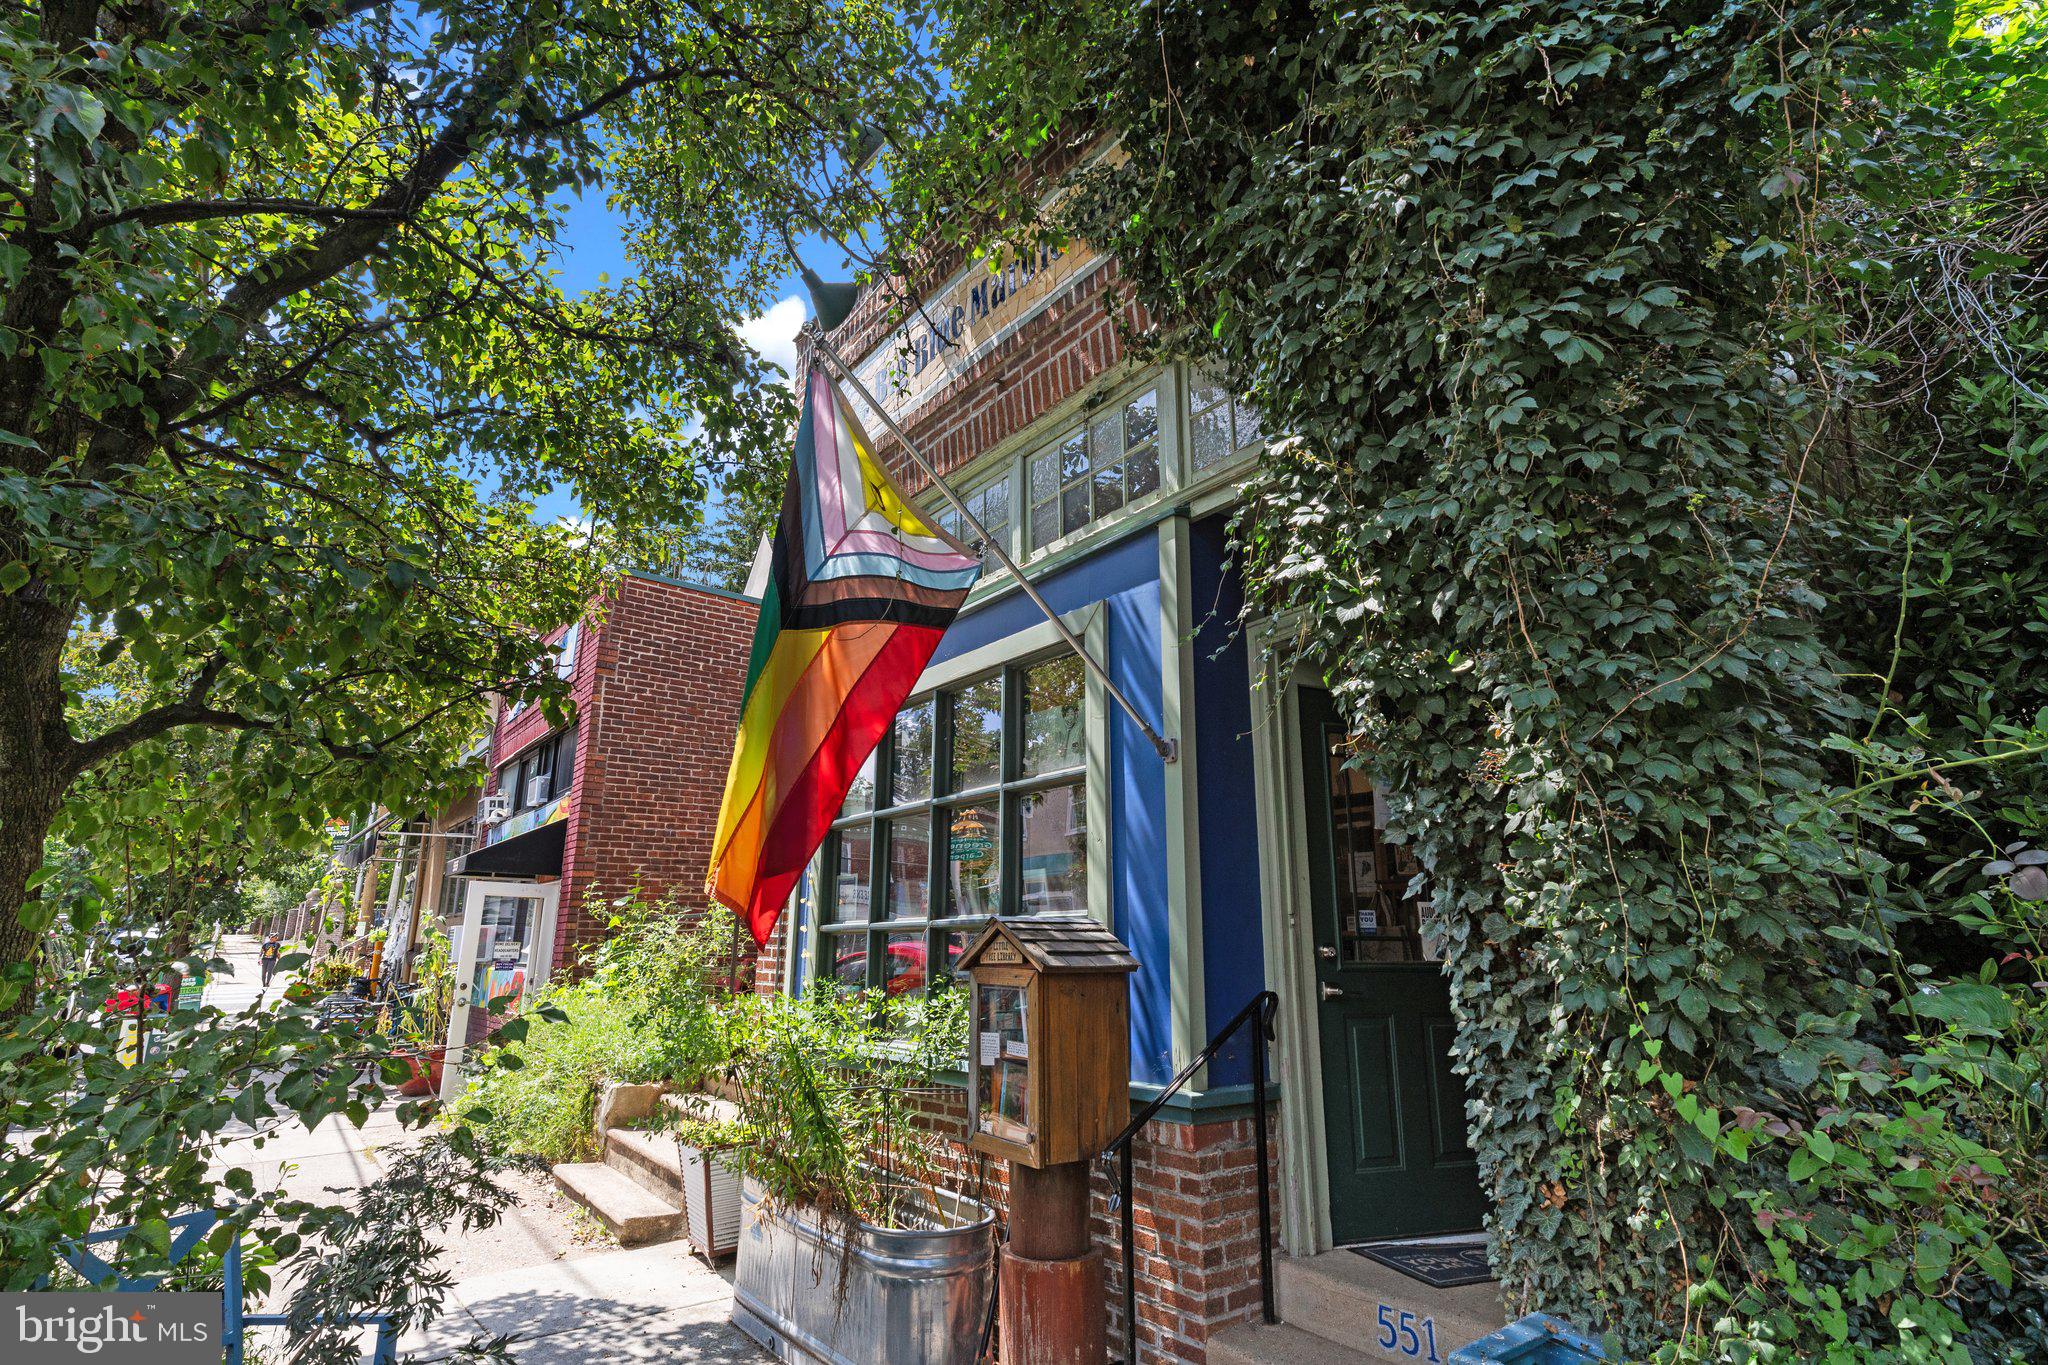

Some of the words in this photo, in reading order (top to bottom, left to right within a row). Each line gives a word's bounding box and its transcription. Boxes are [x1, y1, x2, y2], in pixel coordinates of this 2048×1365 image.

[914, 305, 965, 378] Blue
[993, 941, 1009, 951] LITTLE
[997, 952, 1017, 961] LIBRARY
[1378, 1304, 1441, 1363] 551
